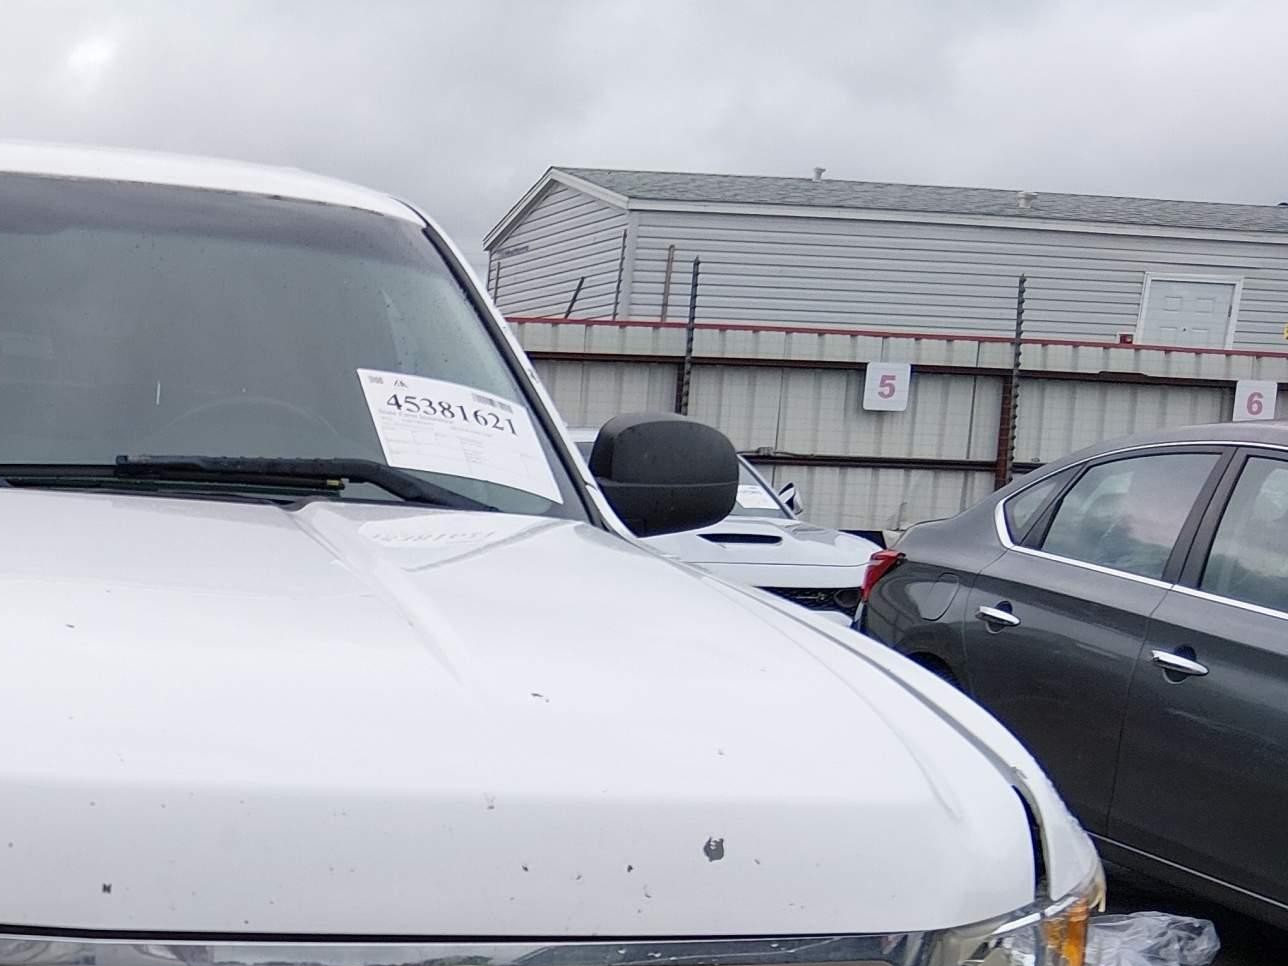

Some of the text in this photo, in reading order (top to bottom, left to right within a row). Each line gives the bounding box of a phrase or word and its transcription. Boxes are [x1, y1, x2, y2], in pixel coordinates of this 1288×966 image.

[877, 374, 897, 400] 5
[386, 393, 518, 437] 45381621
[1246, 391, 1264, 416] 6
